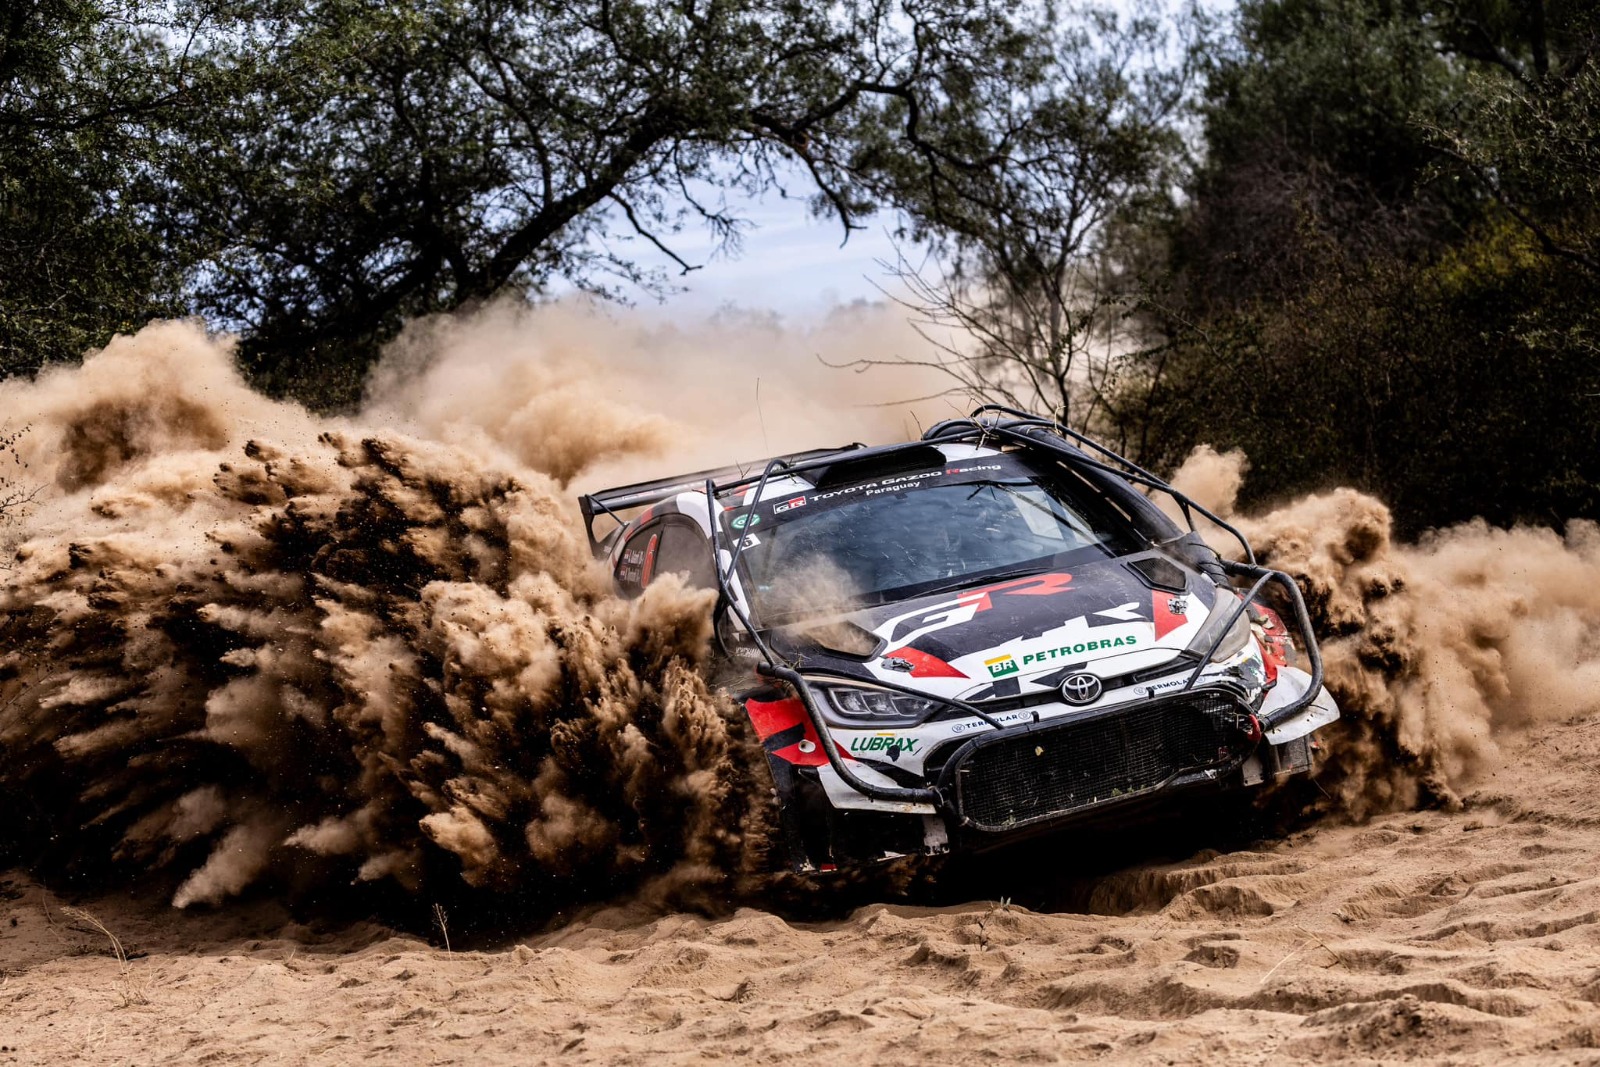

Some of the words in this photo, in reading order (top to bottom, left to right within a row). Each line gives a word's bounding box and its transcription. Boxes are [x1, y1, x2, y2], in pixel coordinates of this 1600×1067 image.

[775, 499, 806, 513] GR
[809, 482, 877, 502] TOYOTA
[881, 470, 942, 485] GAZOO
[946, 463, 1002, 475] Racing
[865, 481, 921, 496] Paraguay
[872, 573, 1076, 650] GR
[992, 660, 1014, 674] BR
[1023, 635, 1137, 665] PETROBRAS
[851, 737, 919, 752] LUBRAX
